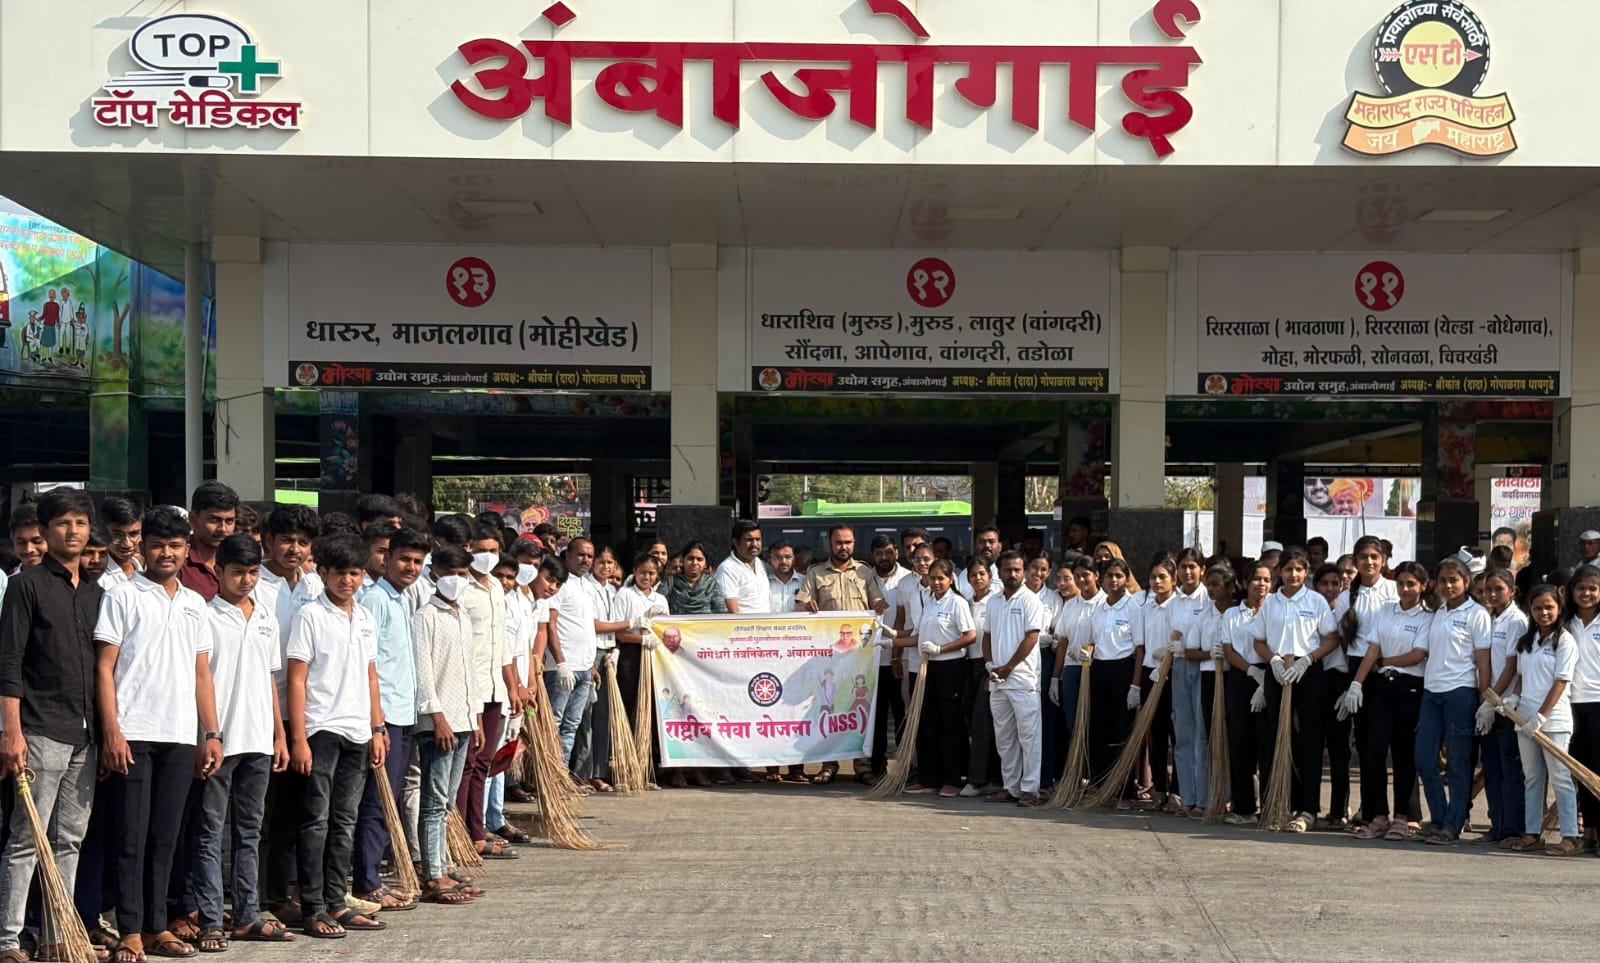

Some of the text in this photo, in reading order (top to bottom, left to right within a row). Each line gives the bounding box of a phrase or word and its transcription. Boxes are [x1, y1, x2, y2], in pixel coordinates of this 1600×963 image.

[1383, 3, 1485, 47] प्रवाशांच्या सेवेसाठी
[153, 33, 230, 57] TOP
[450, 0, 1204, 158] अंबाजोगाई
[94, 89, 301, 126] टॉप मेडिकल
[1354, 95, 1506, 123] महाराष्ट्र राज्य परिवहन
[1366, 127, 1506, 150] जय महाराष्ट्र
[452, 266, 491, 301] १३
[913, 268, 949, 301] १२
[1361, 271, 1399, 306] ११
[306, 315, 638, 352] धारुर, माजलगाव (मोहीखेड)
[761, 308, 835, 329] धाराशिव
[969, 316, 1015, 337] लातुर
[1022, 310, 1101, 334] (वांगदरी)
[1206, 316, 1270, 336] सिरसाळा
[1365, 315, 1430, 335] सिरसाळा
[785, 338, 1074, 363] सौंदना, आपेगाव, वांगदरी, तडोळा
[1261, 343, 1498, 368] मोहा, मोरफळी, सोनवळा, चिचखंडी
[376, 370, 407, 383] उद्योग
[556, 370, 580, 386] (दादा)
[837, 374, 868, 386] उद्योग
[1014, 373, 1038, 390] (दादा)
[1284, 379, 1315, 391] उद्योग
[1463, 377, 1488, 392] (दादा)
[1490, 376, 1526, 392] गोपाळराव
[787, 645, 833, 659] अंबाजोगाई
[665, 704, 868, 741] राष्ट्रीय सेवा योजना (NSS)
